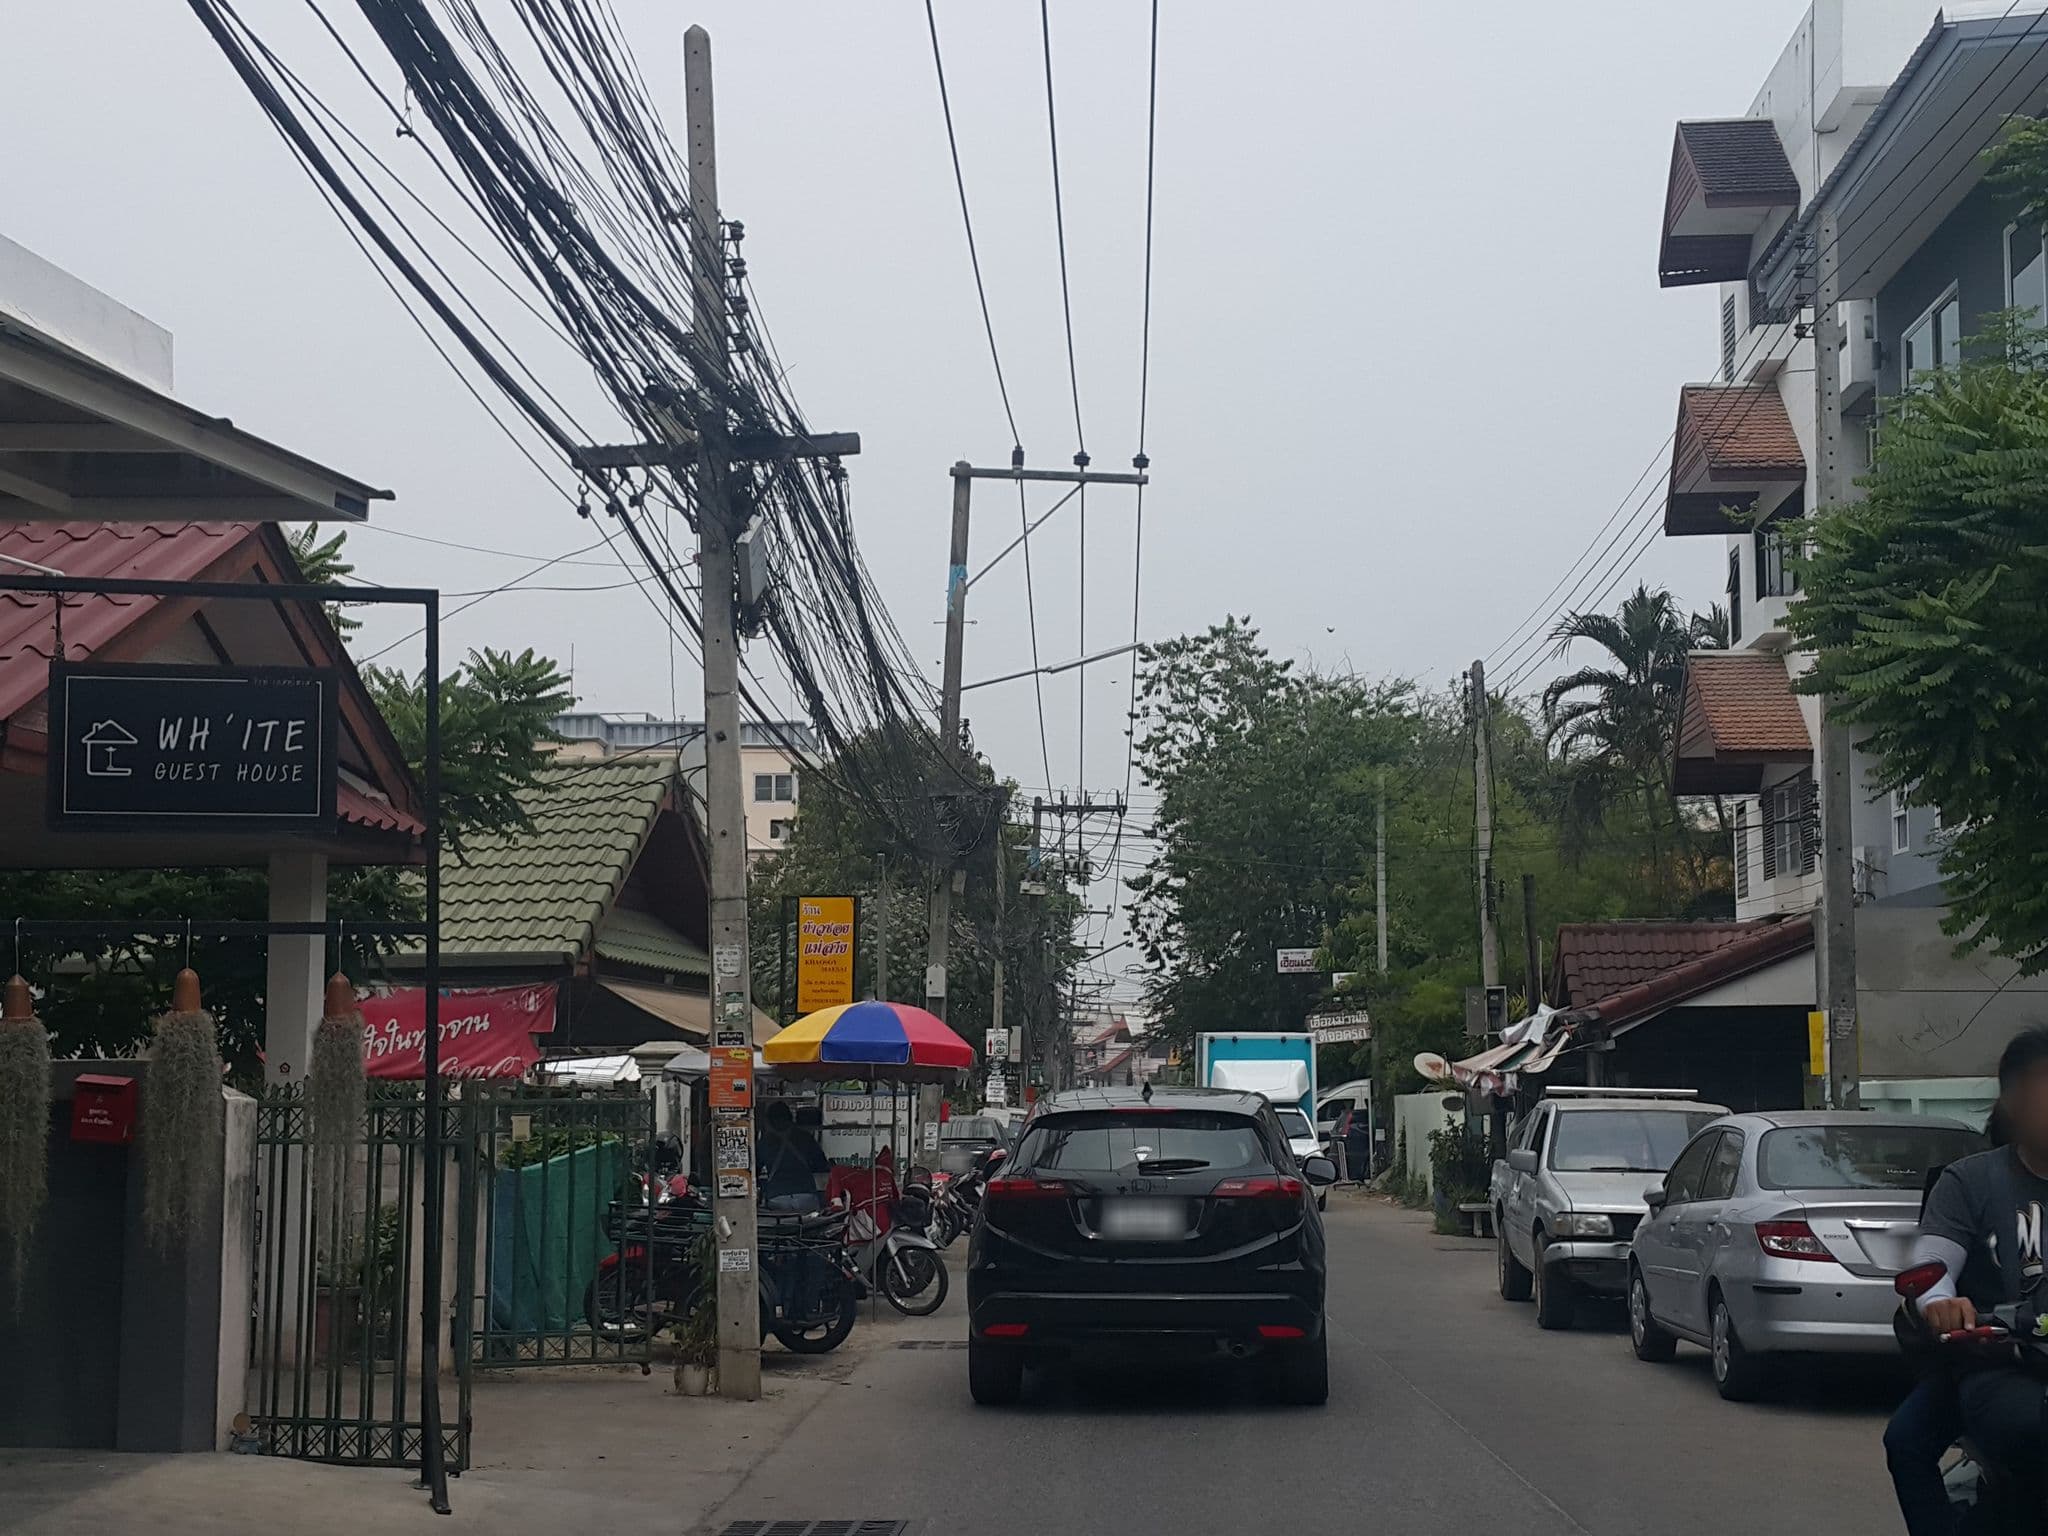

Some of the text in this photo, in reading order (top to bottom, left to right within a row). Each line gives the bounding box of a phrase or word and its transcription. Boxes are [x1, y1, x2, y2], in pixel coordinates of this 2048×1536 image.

[155, 762, 304, 783] GUEST HOUSE
[803, 903, 821, 916] ร้าน
